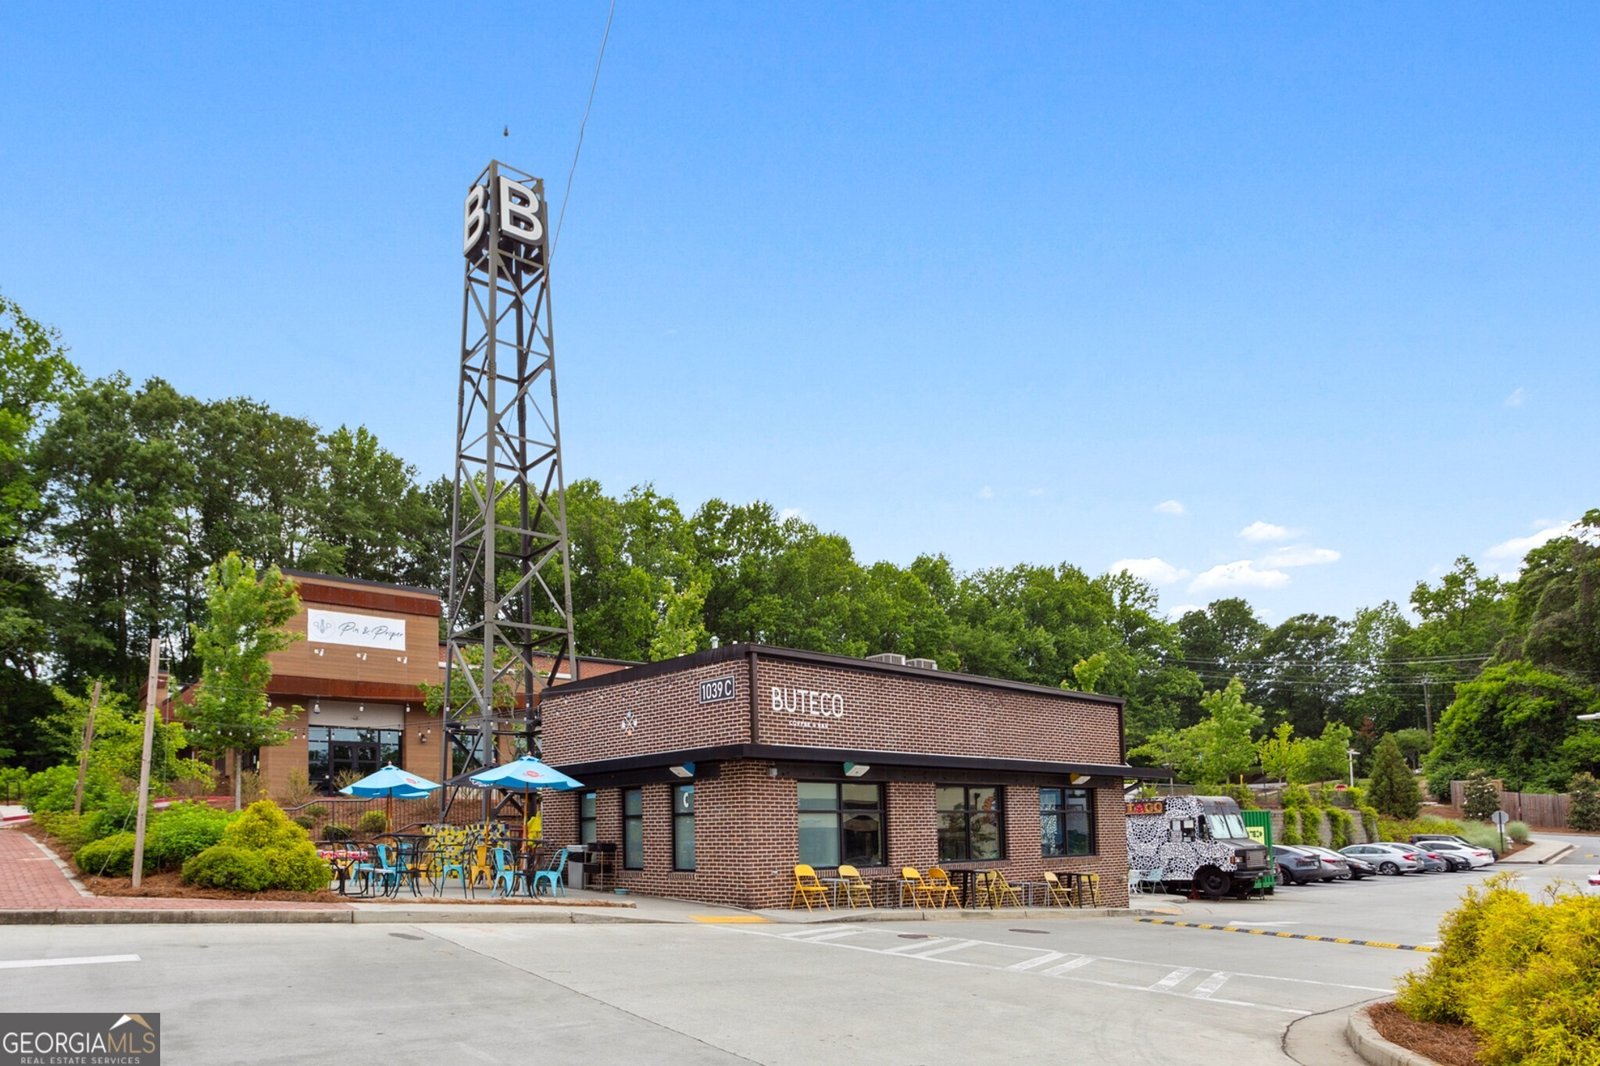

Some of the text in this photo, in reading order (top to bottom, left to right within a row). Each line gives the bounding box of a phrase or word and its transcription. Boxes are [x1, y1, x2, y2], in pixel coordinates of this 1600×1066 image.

[464, 184, 485, 254] B
[499, 175, 543, 241] B
[338, 621, 359, 636] Pin
[362, 626, 370, 635] &
[702, 679, 732, 701] 1039 C
[771, 687, 844, 718] BUTECO
